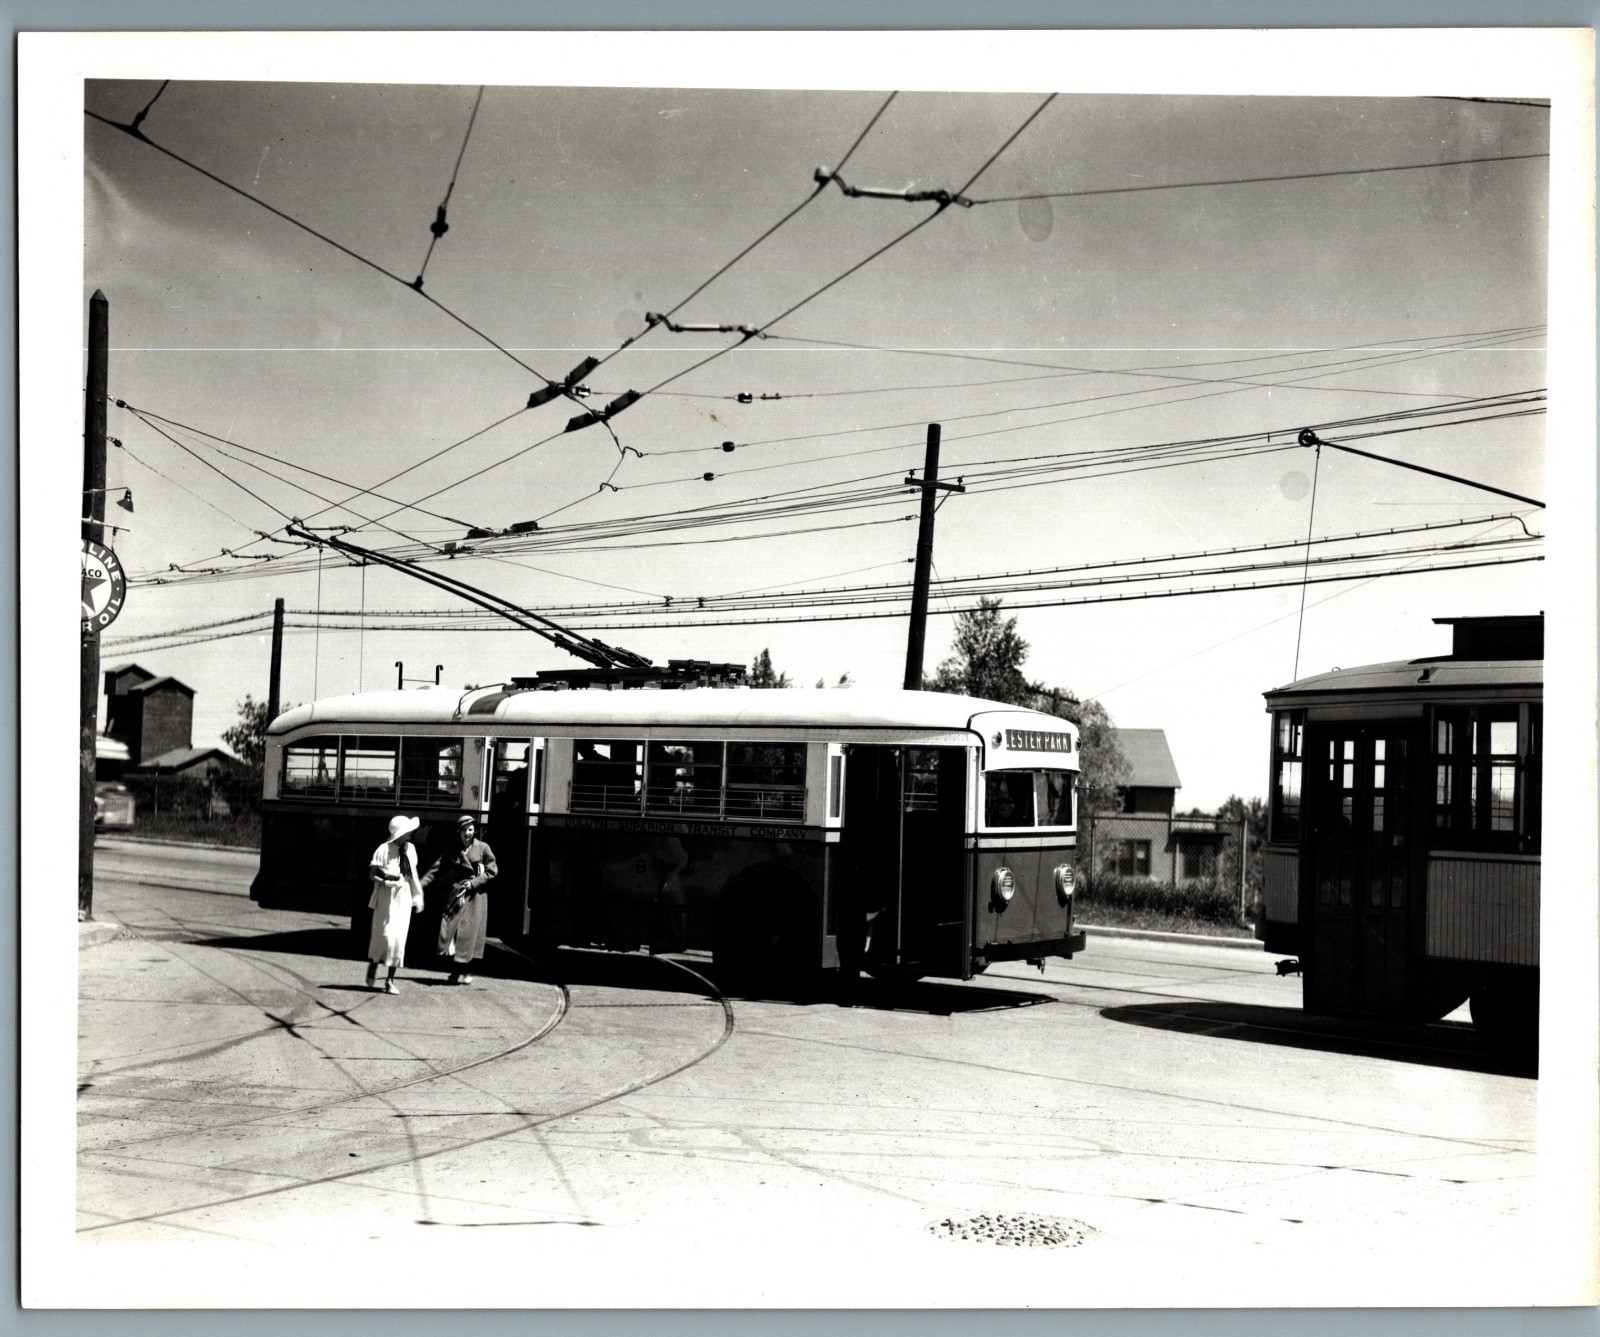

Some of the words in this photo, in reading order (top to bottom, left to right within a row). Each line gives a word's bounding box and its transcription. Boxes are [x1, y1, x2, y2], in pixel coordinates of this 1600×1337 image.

[99, 598, 121, 625] OIL
[687, 824, 738, 836] TRANSIT
[750, 827, 808, 839] COMPANY
